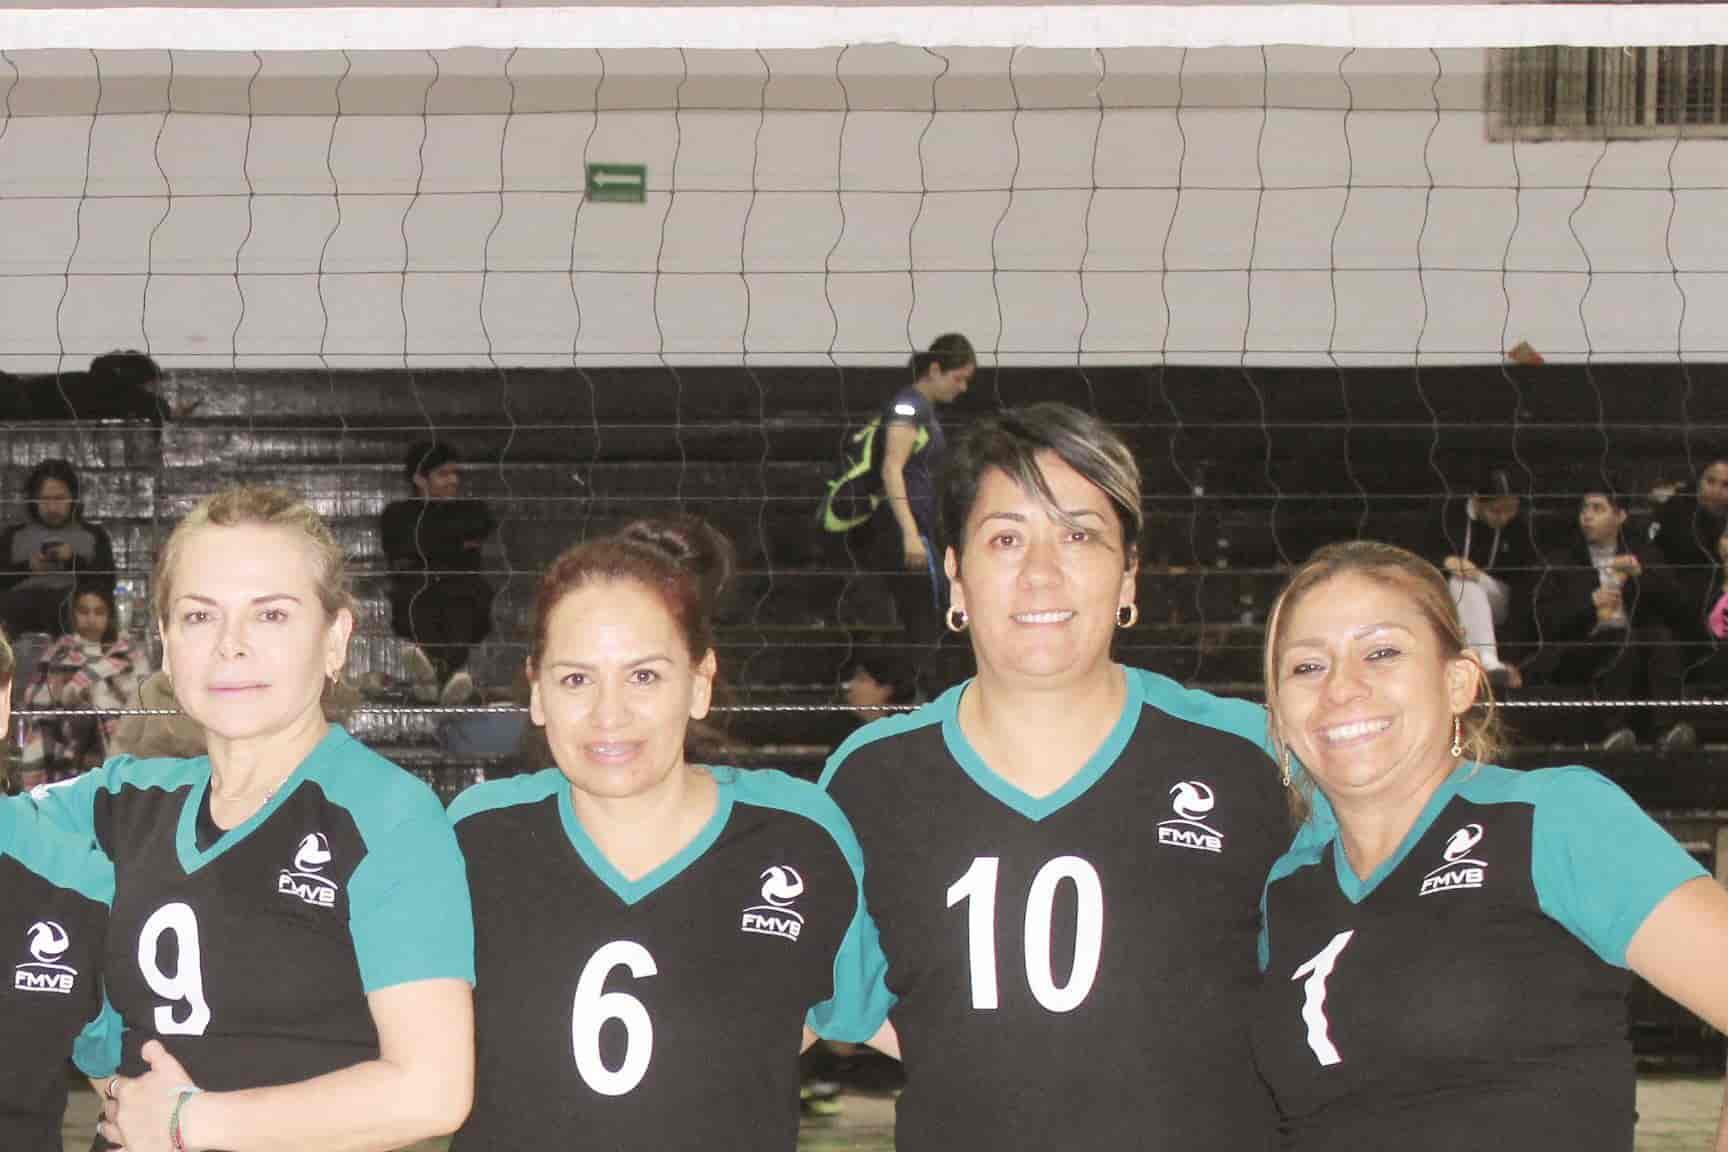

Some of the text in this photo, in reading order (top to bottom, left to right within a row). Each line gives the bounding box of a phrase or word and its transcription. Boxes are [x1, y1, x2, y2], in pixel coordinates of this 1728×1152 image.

[1158, 826, 1222, 849] FMVB
[1420, 868, 1484, 893] FMVB
[742, 913, 801, 937] FMVB
[946, 855, 1104, 1013] 10
[15, 970, 74, 989] FMVB
[137, 902, 211, 1037] 9
[1291, 929, 1355, 1067] 1
[571, 939, 658, 1097] 6
